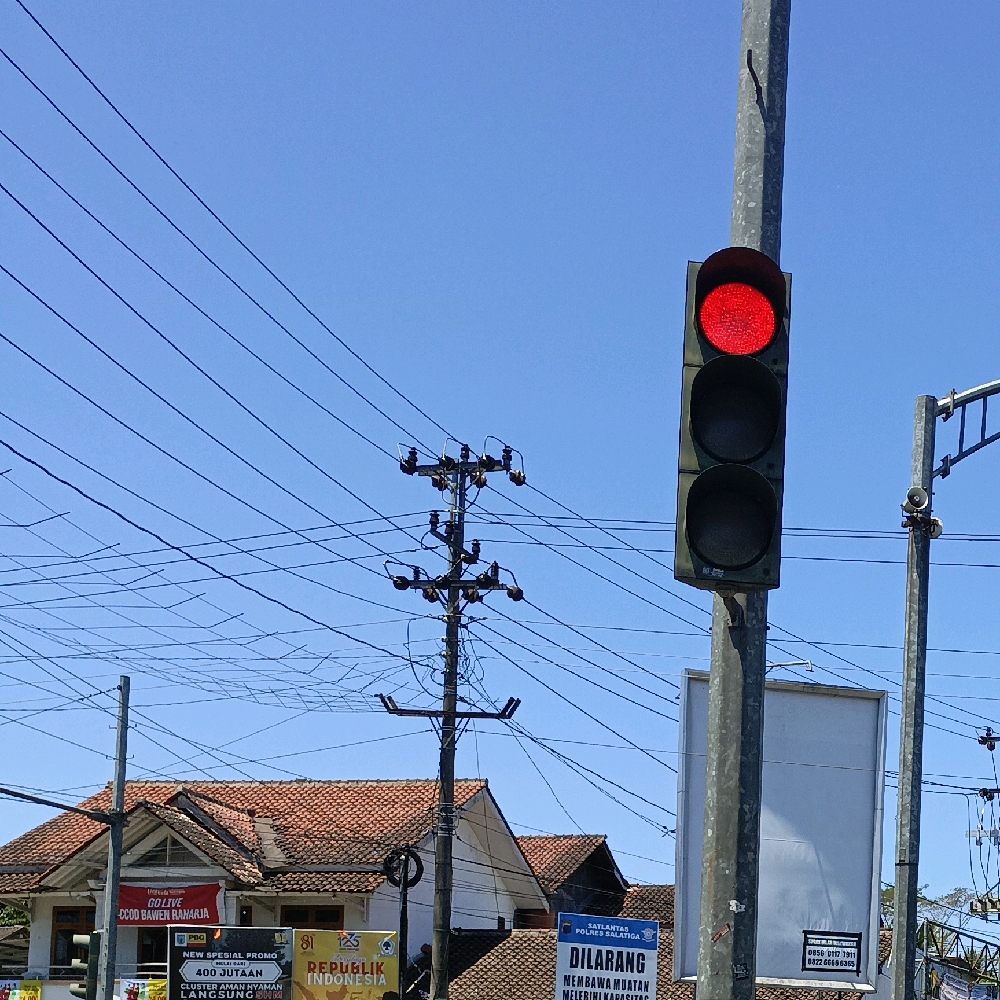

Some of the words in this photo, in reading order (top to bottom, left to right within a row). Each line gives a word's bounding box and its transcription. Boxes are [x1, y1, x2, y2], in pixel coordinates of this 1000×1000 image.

[161, 897, 183, 908] LIVE
[141, 909, 170, 921] BAWEN
[171, 907, 209, 920] RAHARJA
[587, 922, 629, 933] SATLANTAS
[575, 928, 604, 937] POLRES
[604, 931, 641, 940] SALATIGA
[182, 951, 204, 959] NEW
[569, 946, 646, 974] DILARANG
[195, 968, 217, 977] 400
[219, 968, 263, 978] JUTAAN
[307, 961, 385, 975] REPUBLIK
[307, 972, 387, 986] INDONESIA
[563, 974, 611, 990] MEMBAWA
[613, 978, 650, 993] MUATAN
[180, 983, 218, 991] CLUSTER
[219, 983, 245, 991] AMAN
[246, 983, 283, 991] NYAMAN
[180, 990, 254, 999] LANGSUNG
